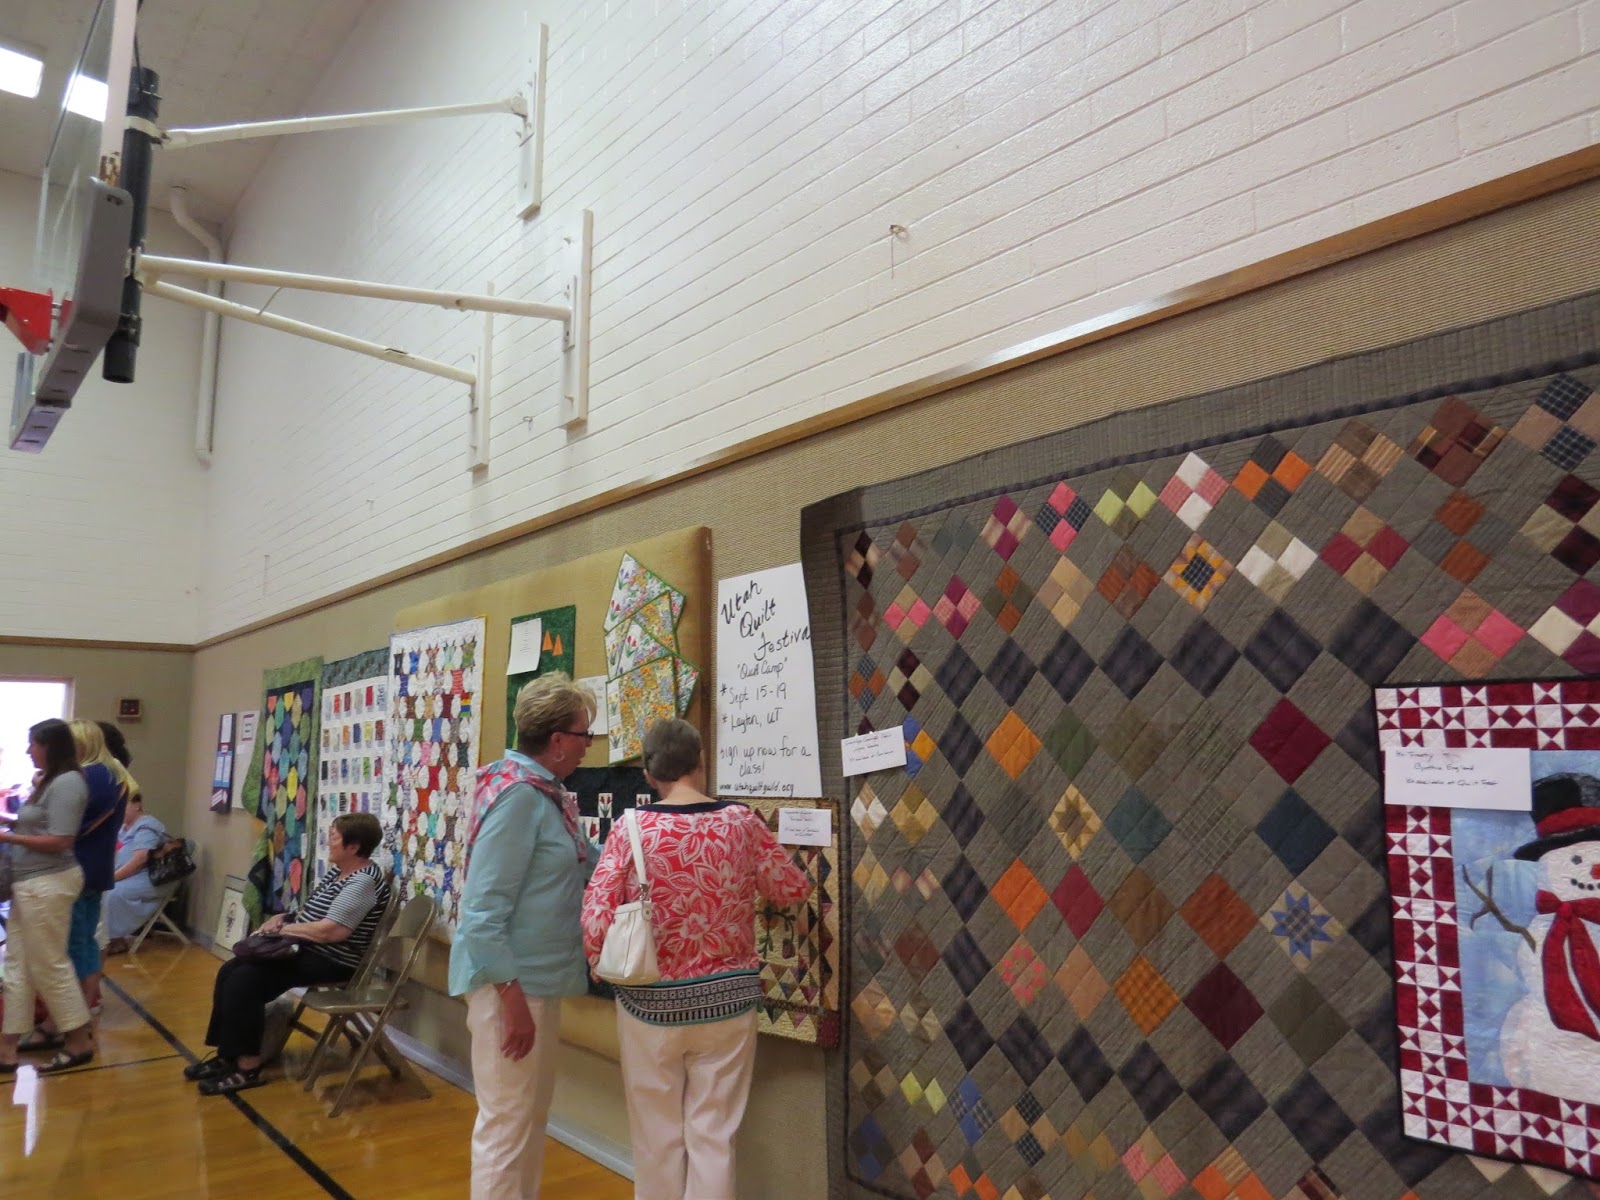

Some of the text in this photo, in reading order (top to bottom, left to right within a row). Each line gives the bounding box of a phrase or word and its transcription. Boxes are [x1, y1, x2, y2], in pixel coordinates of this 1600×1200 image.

[721, 580, 762, 624] Utah
[740, 598, 776, 638] Quilt
[754, 626, 811, 661] Festiva
[729, 687, 749, 709] Sept
[743, 747, 755, 761] up
[757, 746, 776, 756] now
[780, 736, 797, 757] for
[801, 746, 811, 757] a
